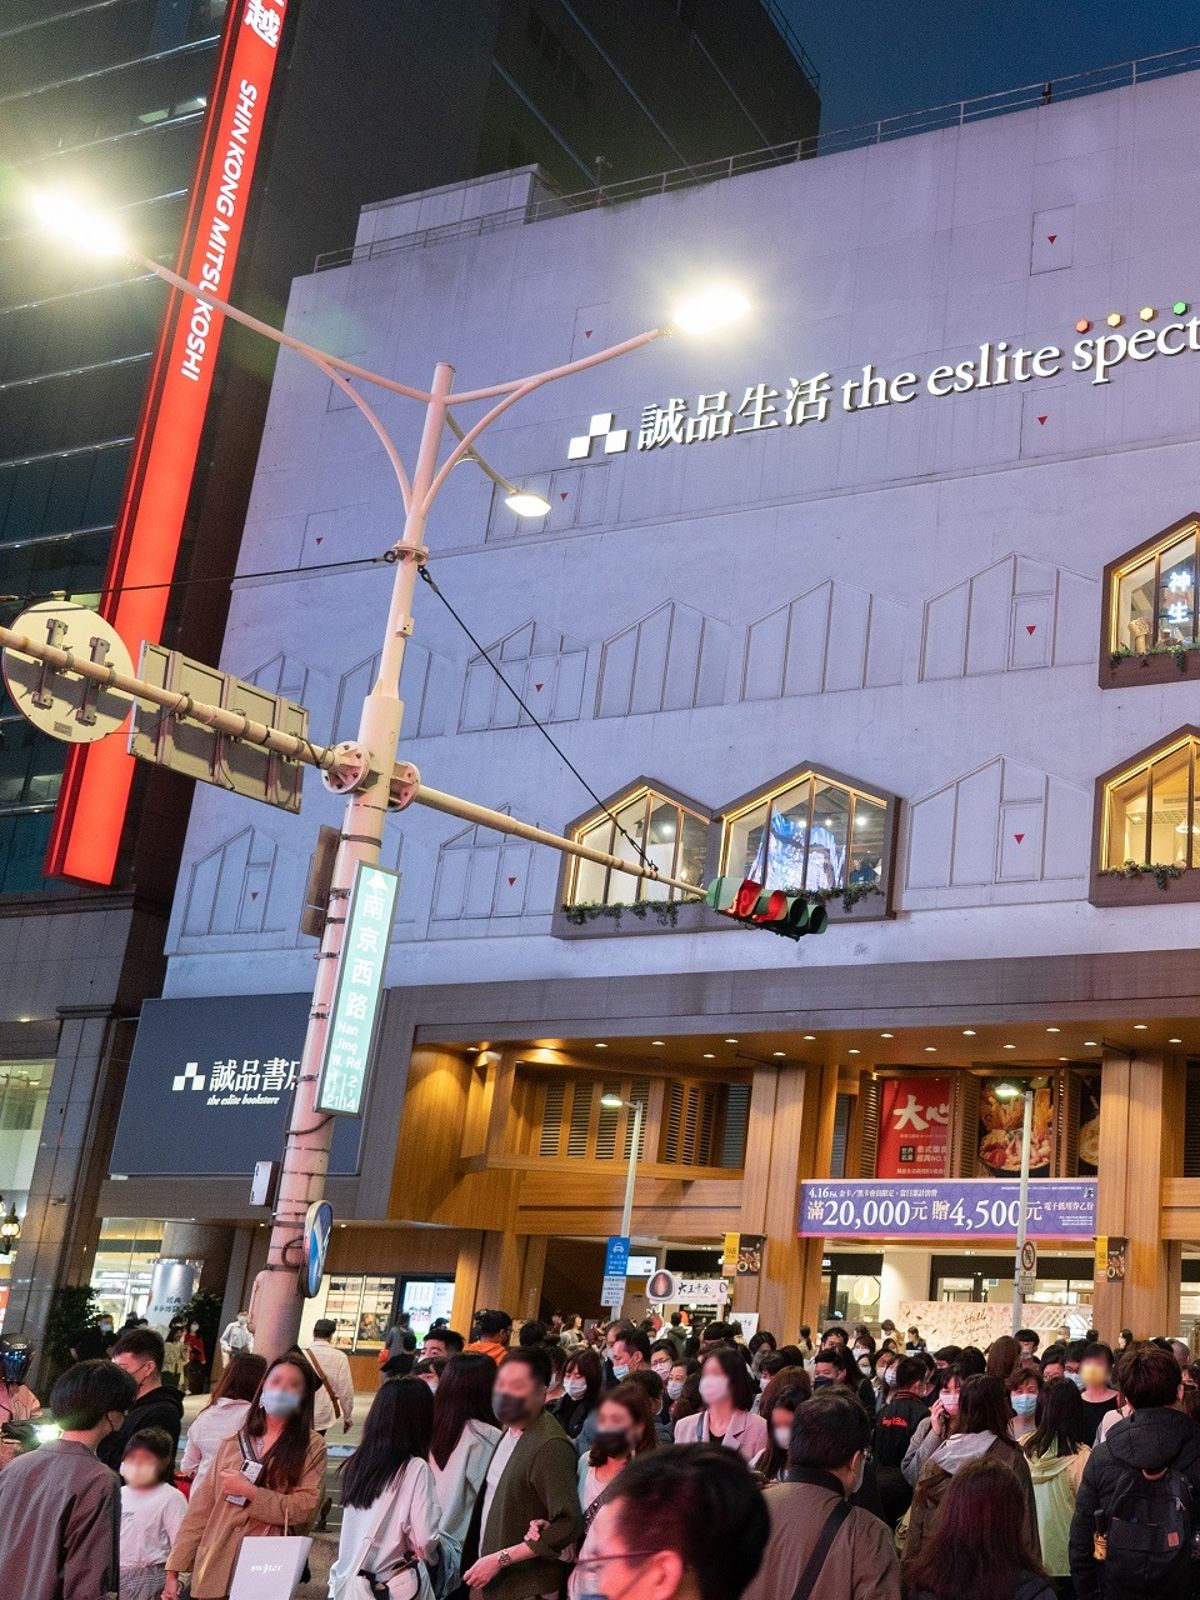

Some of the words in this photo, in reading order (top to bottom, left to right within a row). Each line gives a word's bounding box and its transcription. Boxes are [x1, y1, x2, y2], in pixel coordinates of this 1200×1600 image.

[244, 0, 284, 48] 越
[231, 79, 257, 145] SHIN
[216, 141, 246, 218] KONG
[637, 371, 831, 451] 誠品生活
[841, 364, 918, 412] the
[927, 342, 1061, 397] eslite
[343, 893, 385, 1021] 南京西路
[333, 1039, 358, 1055] Jing
[337, 1021, 359, 1036] Nan
[241, 1093, 280, 1105] bookstore
[892, 1094, 950, 1131] 大心
